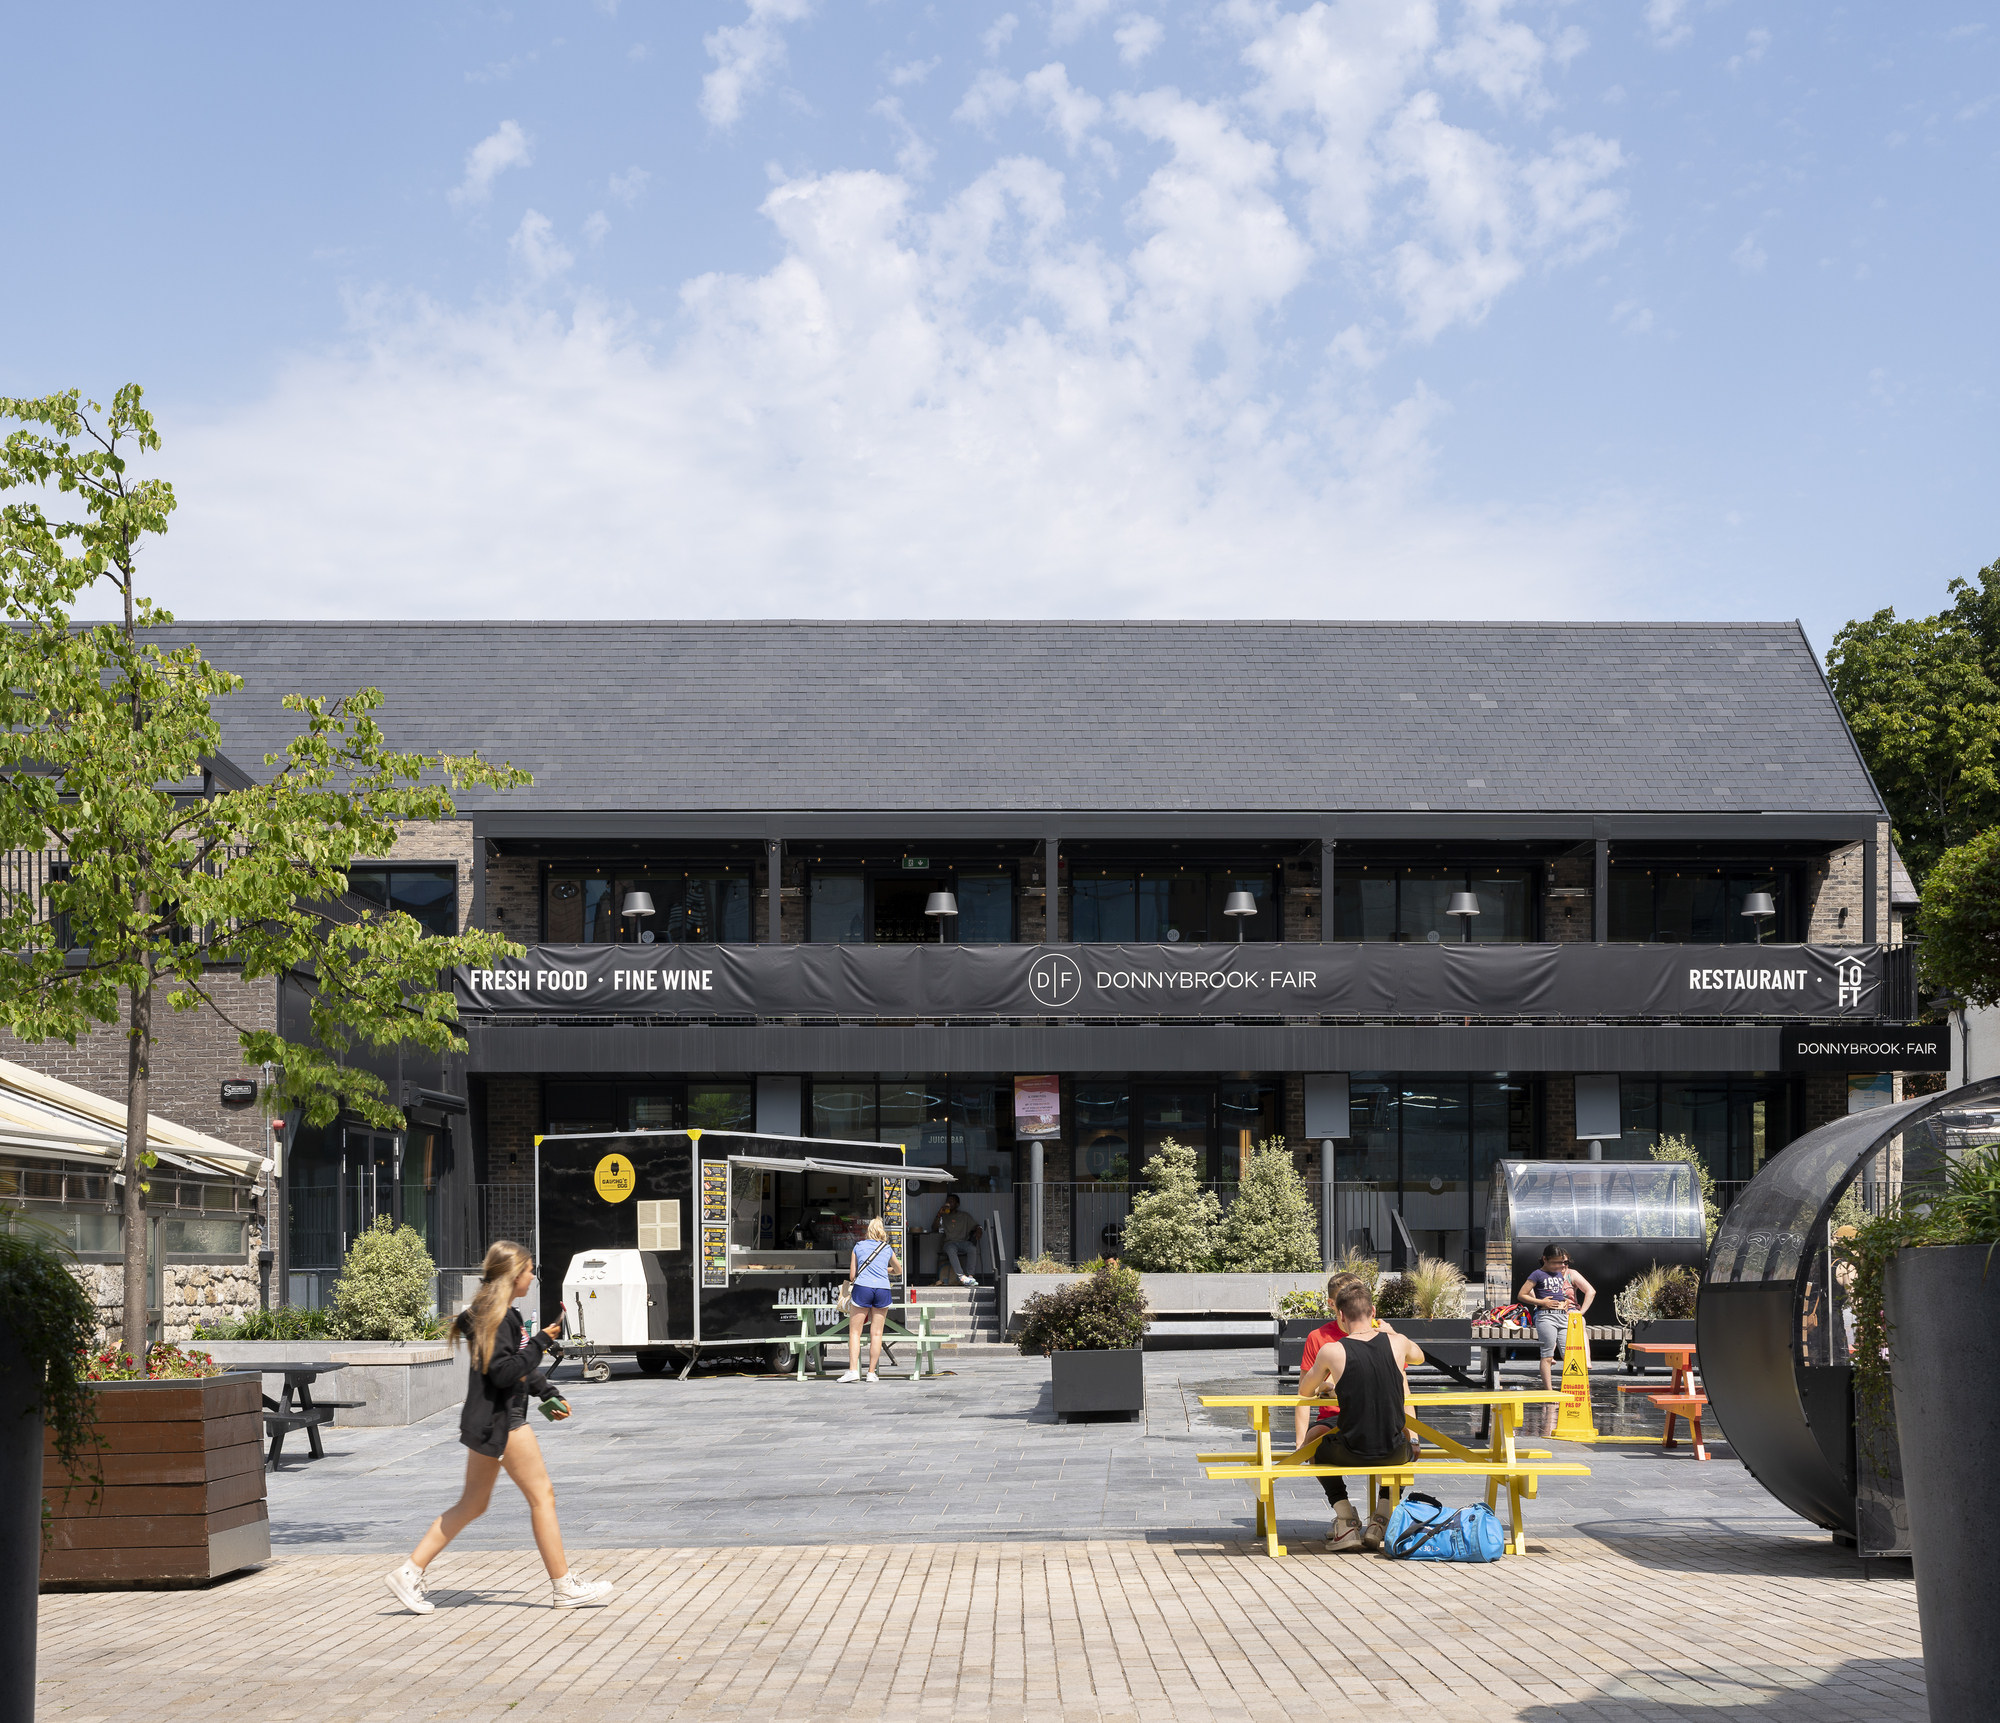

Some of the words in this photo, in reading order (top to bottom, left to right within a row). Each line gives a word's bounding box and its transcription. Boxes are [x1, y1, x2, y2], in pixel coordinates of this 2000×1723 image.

[470, 970, 529, 991] FRESH
[537, 970, 588, 991] FOOD
[613, 969, 657, 991] FINE
[662, 969, 713, 991] WINE
[1096, 971, 1259, 989] DONNYBROOK
[1270, 971, 1317, 989] FAIR
[1689, 969, 1807, 990] RESTAURANT
[1798, 1042, 1900, 1055] DONNYBROOK
[1907, 1042, 1937, 1055] FAIR
[951, 1135, 964, 1144] BAR
[778, 1282, 840, 1305] GAUCHO'S
[815, 1308, 840, 1326] DOG
